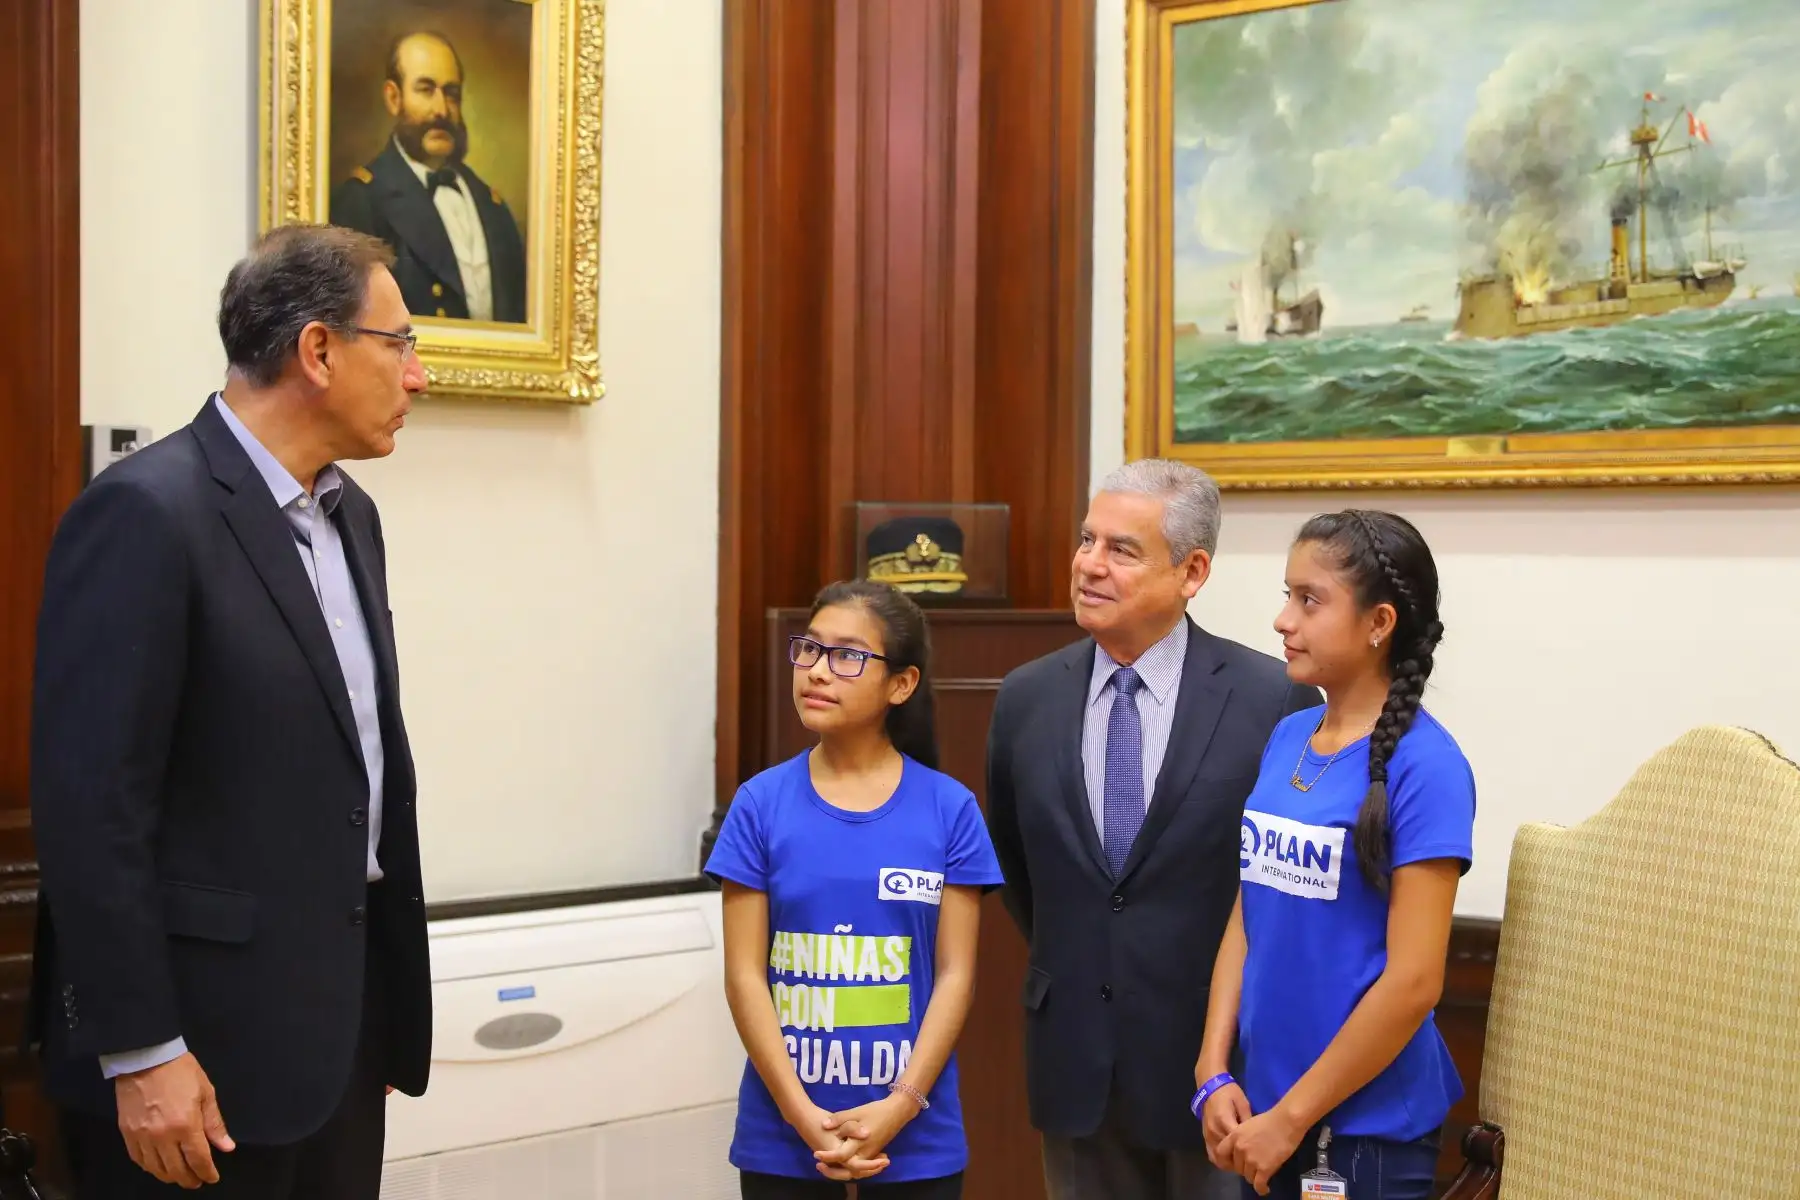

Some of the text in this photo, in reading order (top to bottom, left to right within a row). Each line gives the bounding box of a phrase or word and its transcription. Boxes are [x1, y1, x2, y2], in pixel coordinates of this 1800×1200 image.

[1264, 829, 1331, 873] PLAN
[1261, 864, 1327, 888] INTERNATIONAL
[773, 924, 905, 982] #NIÑAS
[775, 981, 836, 1033] CON
